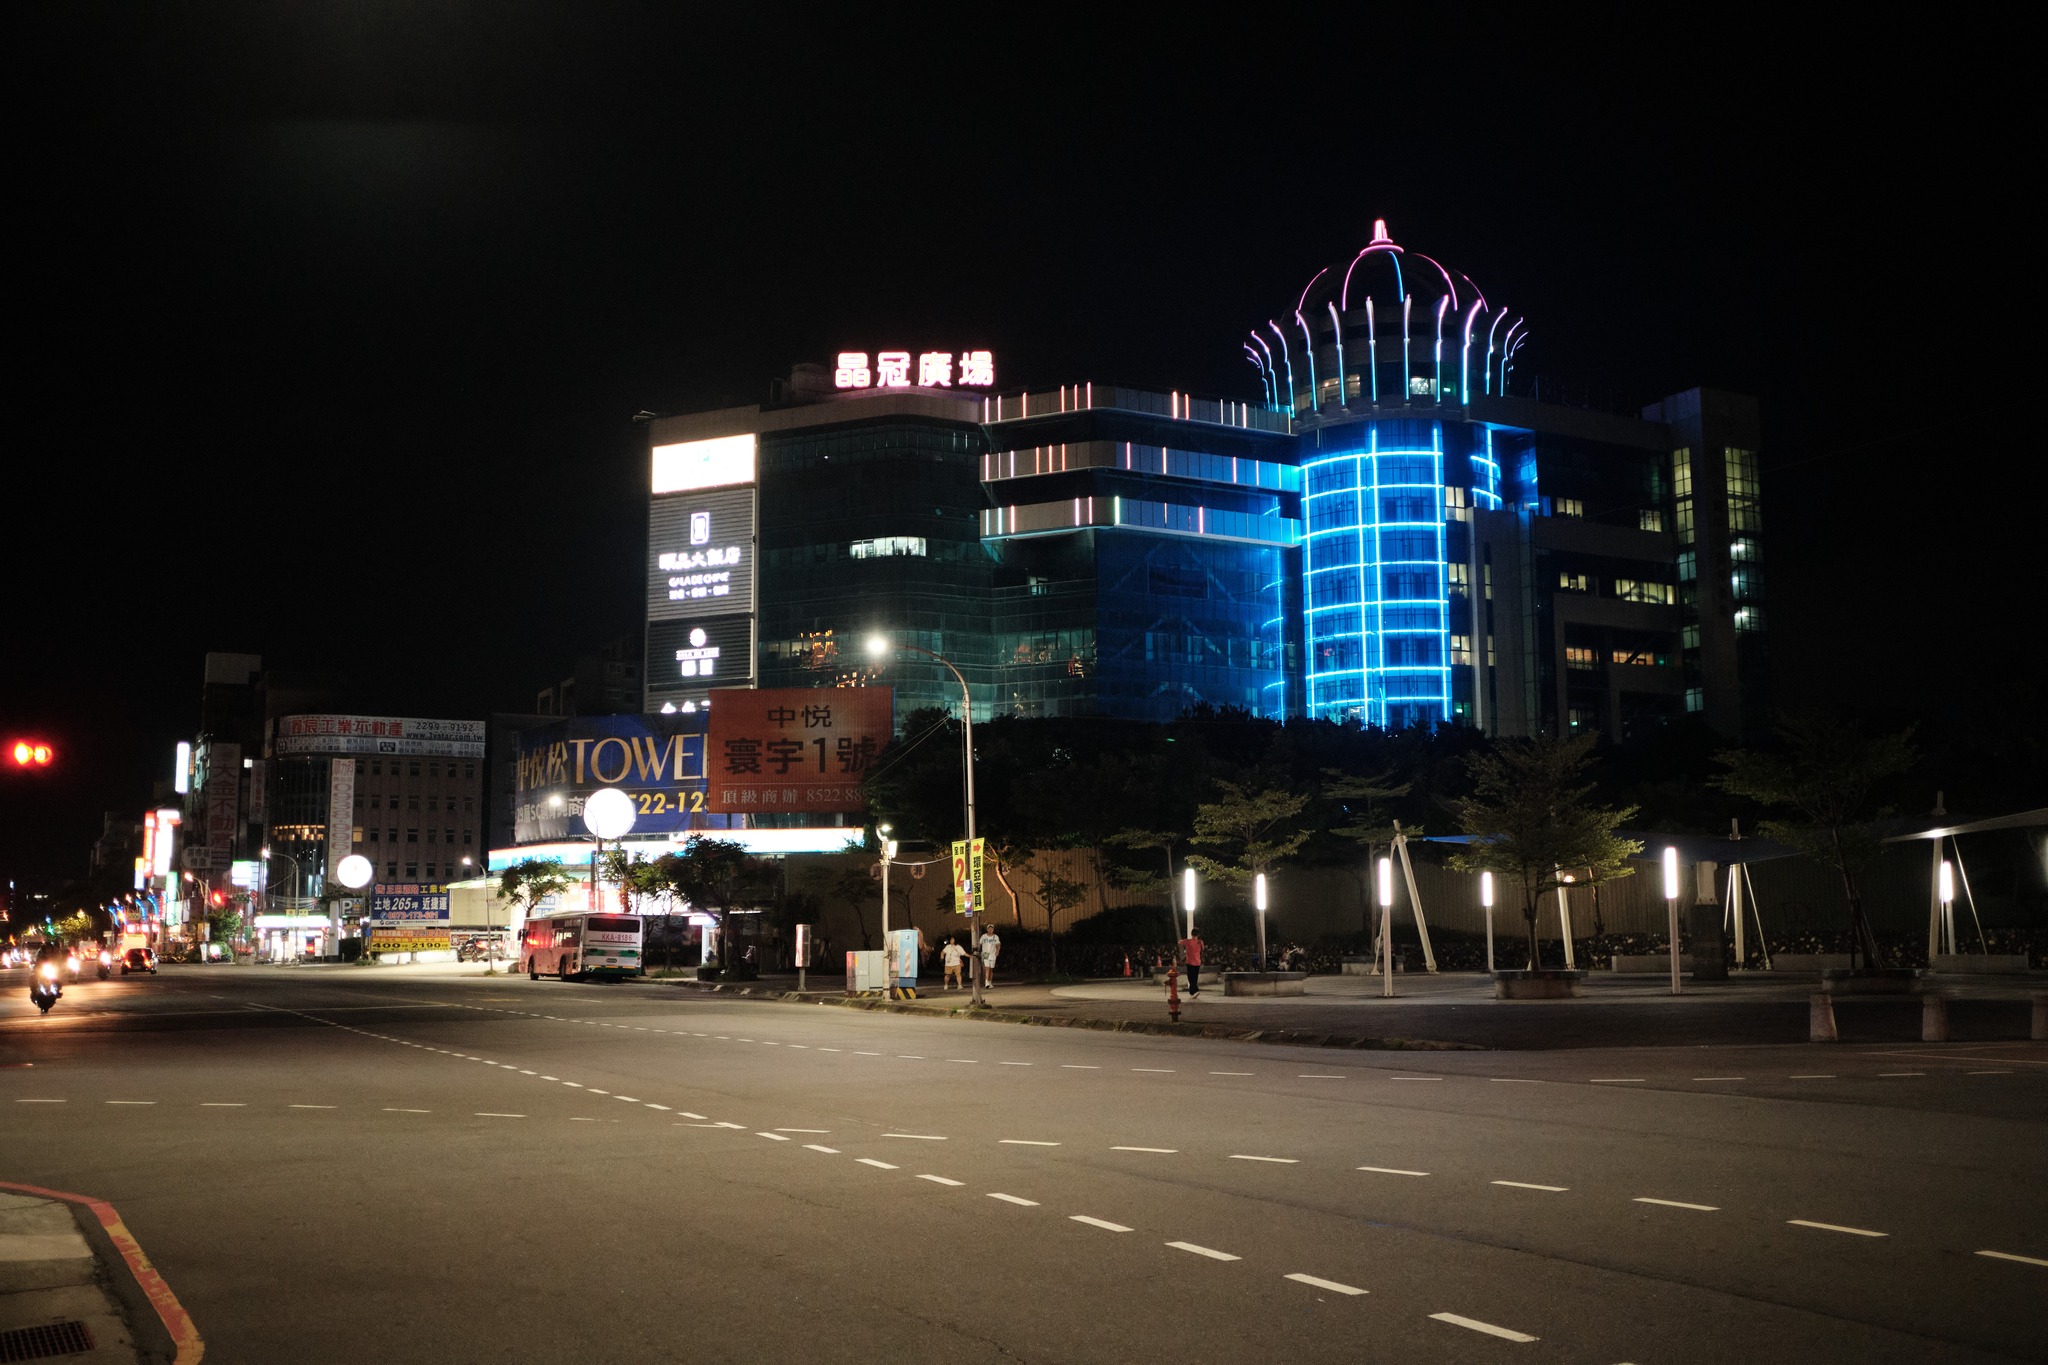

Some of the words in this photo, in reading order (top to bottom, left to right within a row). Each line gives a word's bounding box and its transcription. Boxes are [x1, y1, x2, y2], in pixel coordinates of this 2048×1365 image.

[835, 351, 994, 388] 晶冠廣場
[568, 733, 709, 784] TOWE
[806, 788, 840, 802] 8522
[845, 788, 867, 802] 88
